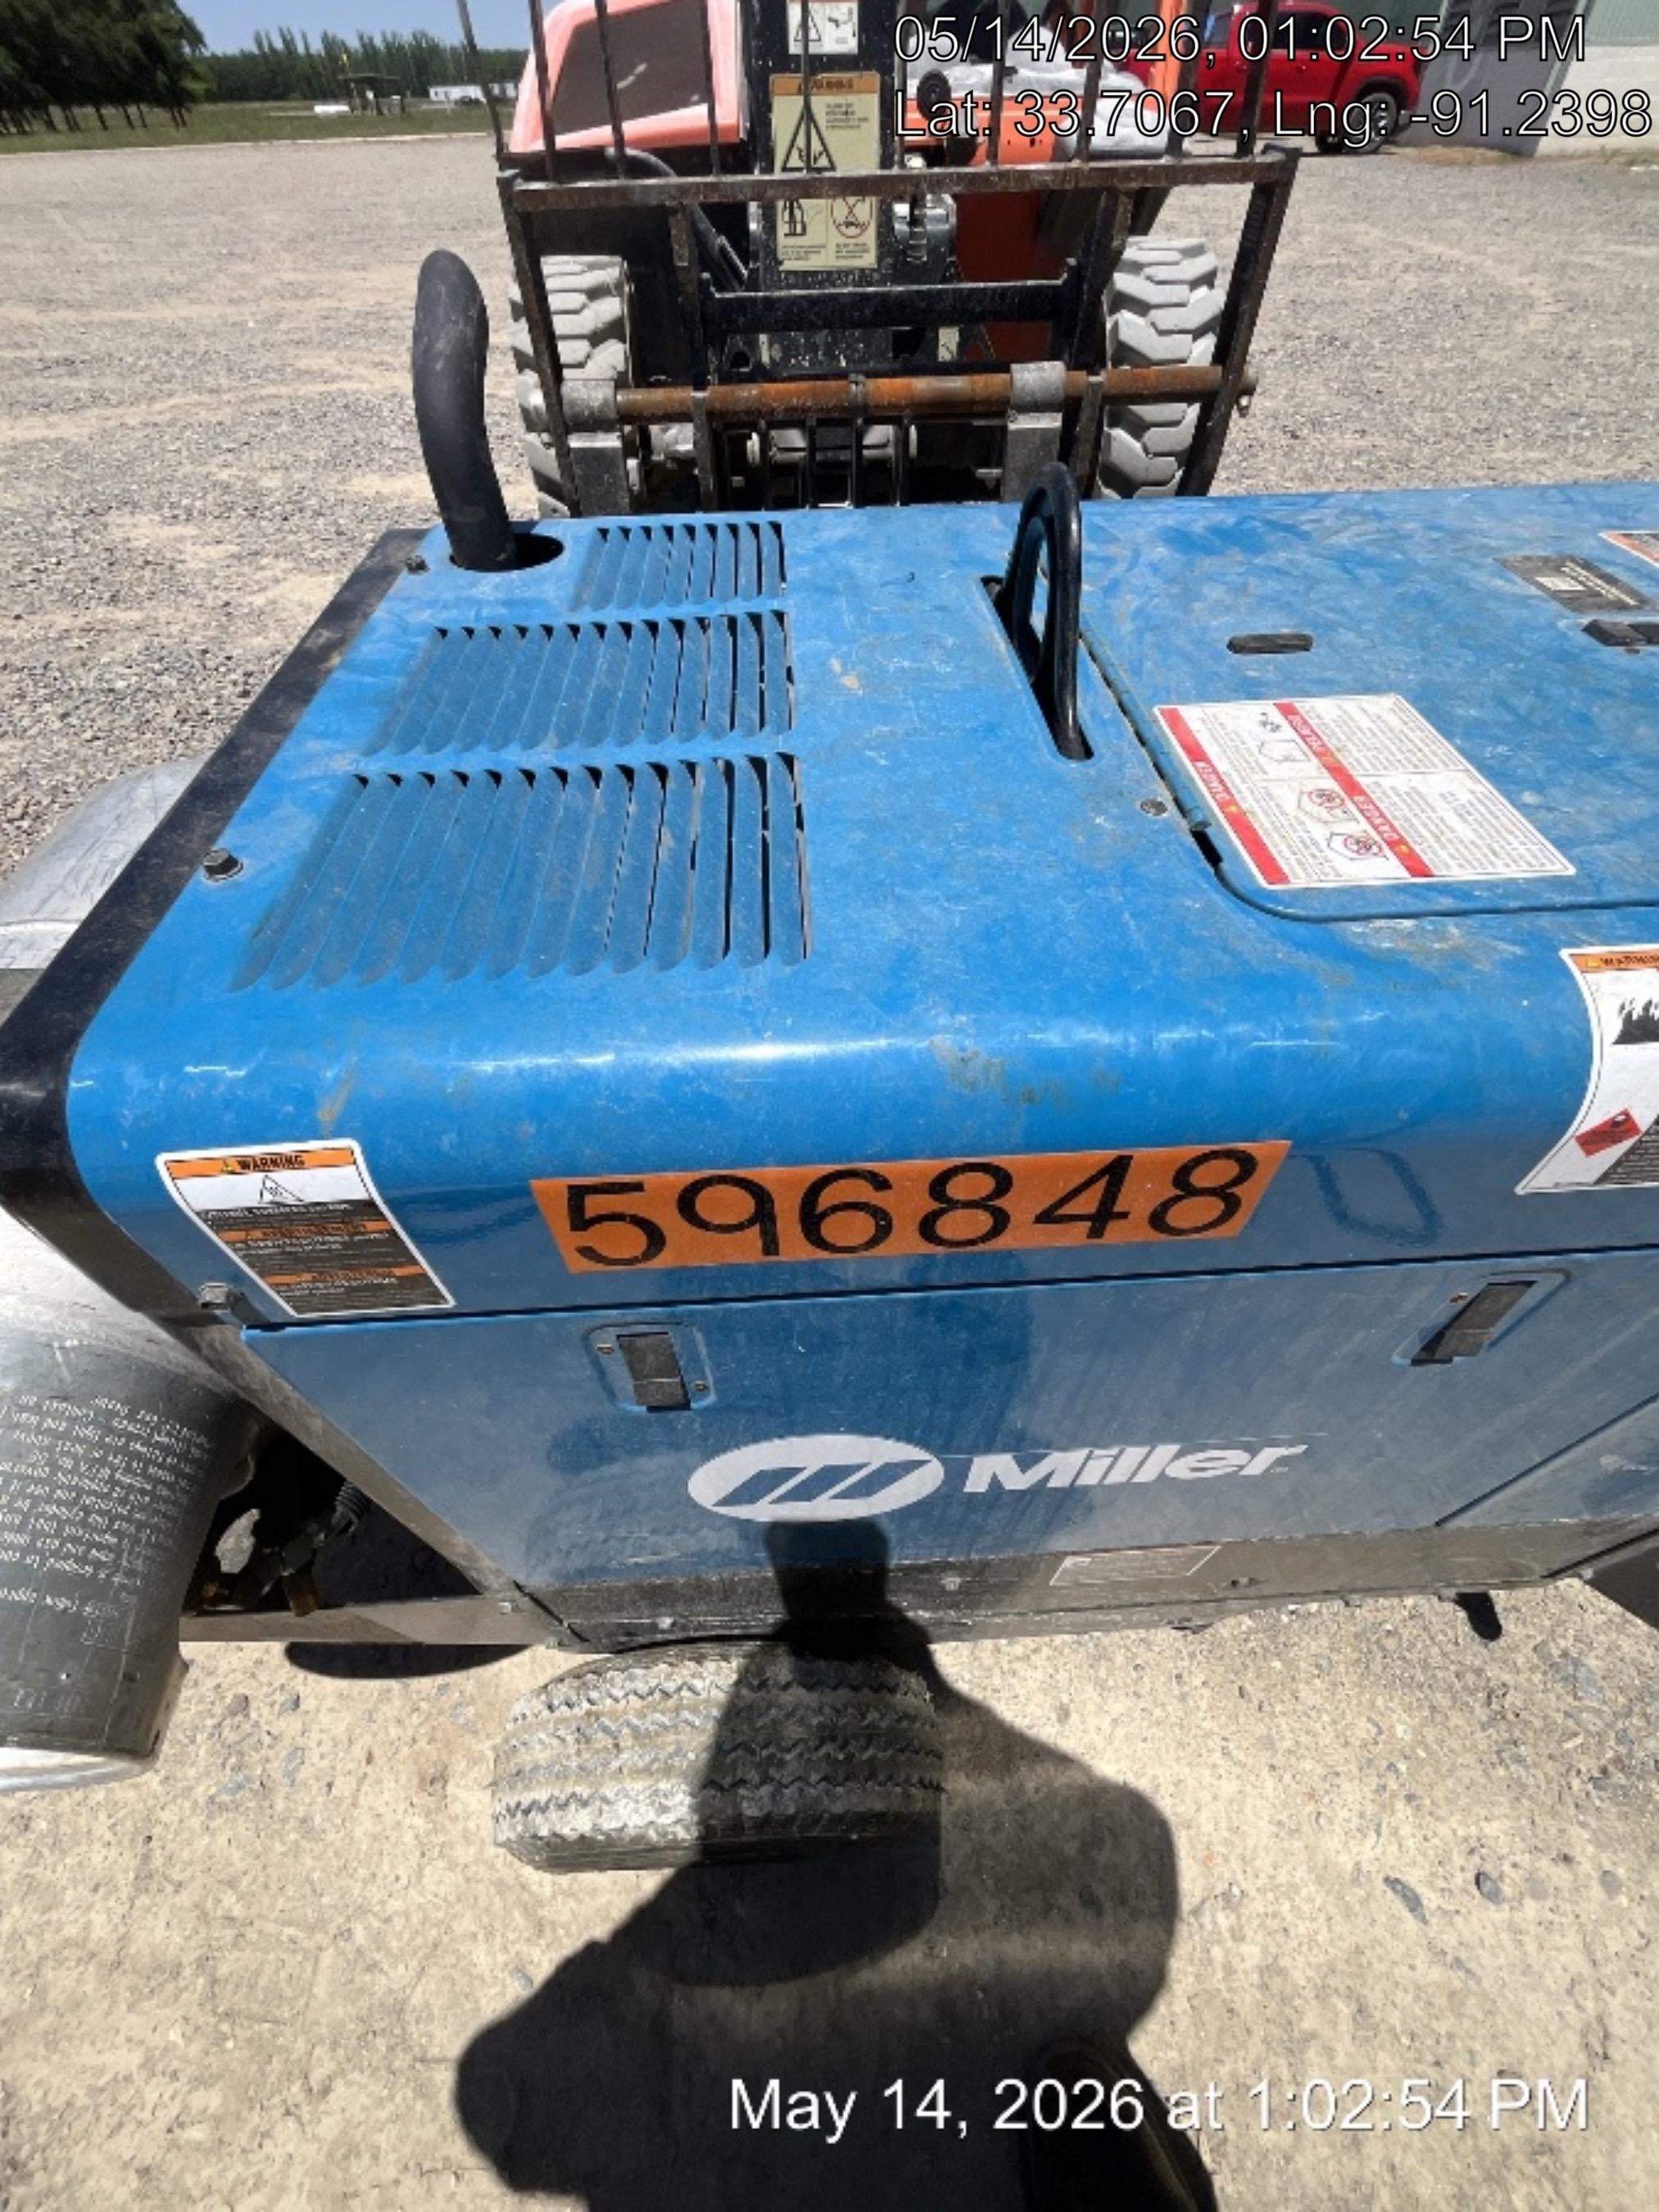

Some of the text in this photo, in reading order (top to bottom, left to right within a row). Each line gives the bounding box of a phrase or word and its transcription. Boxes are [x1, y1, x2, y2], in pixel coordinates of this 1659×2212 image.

[235, 1154, 305, 1171] WARNING
[565, 1148, 1261, 1267] 596848
[963, 1444, 1309, 1493] Miller
